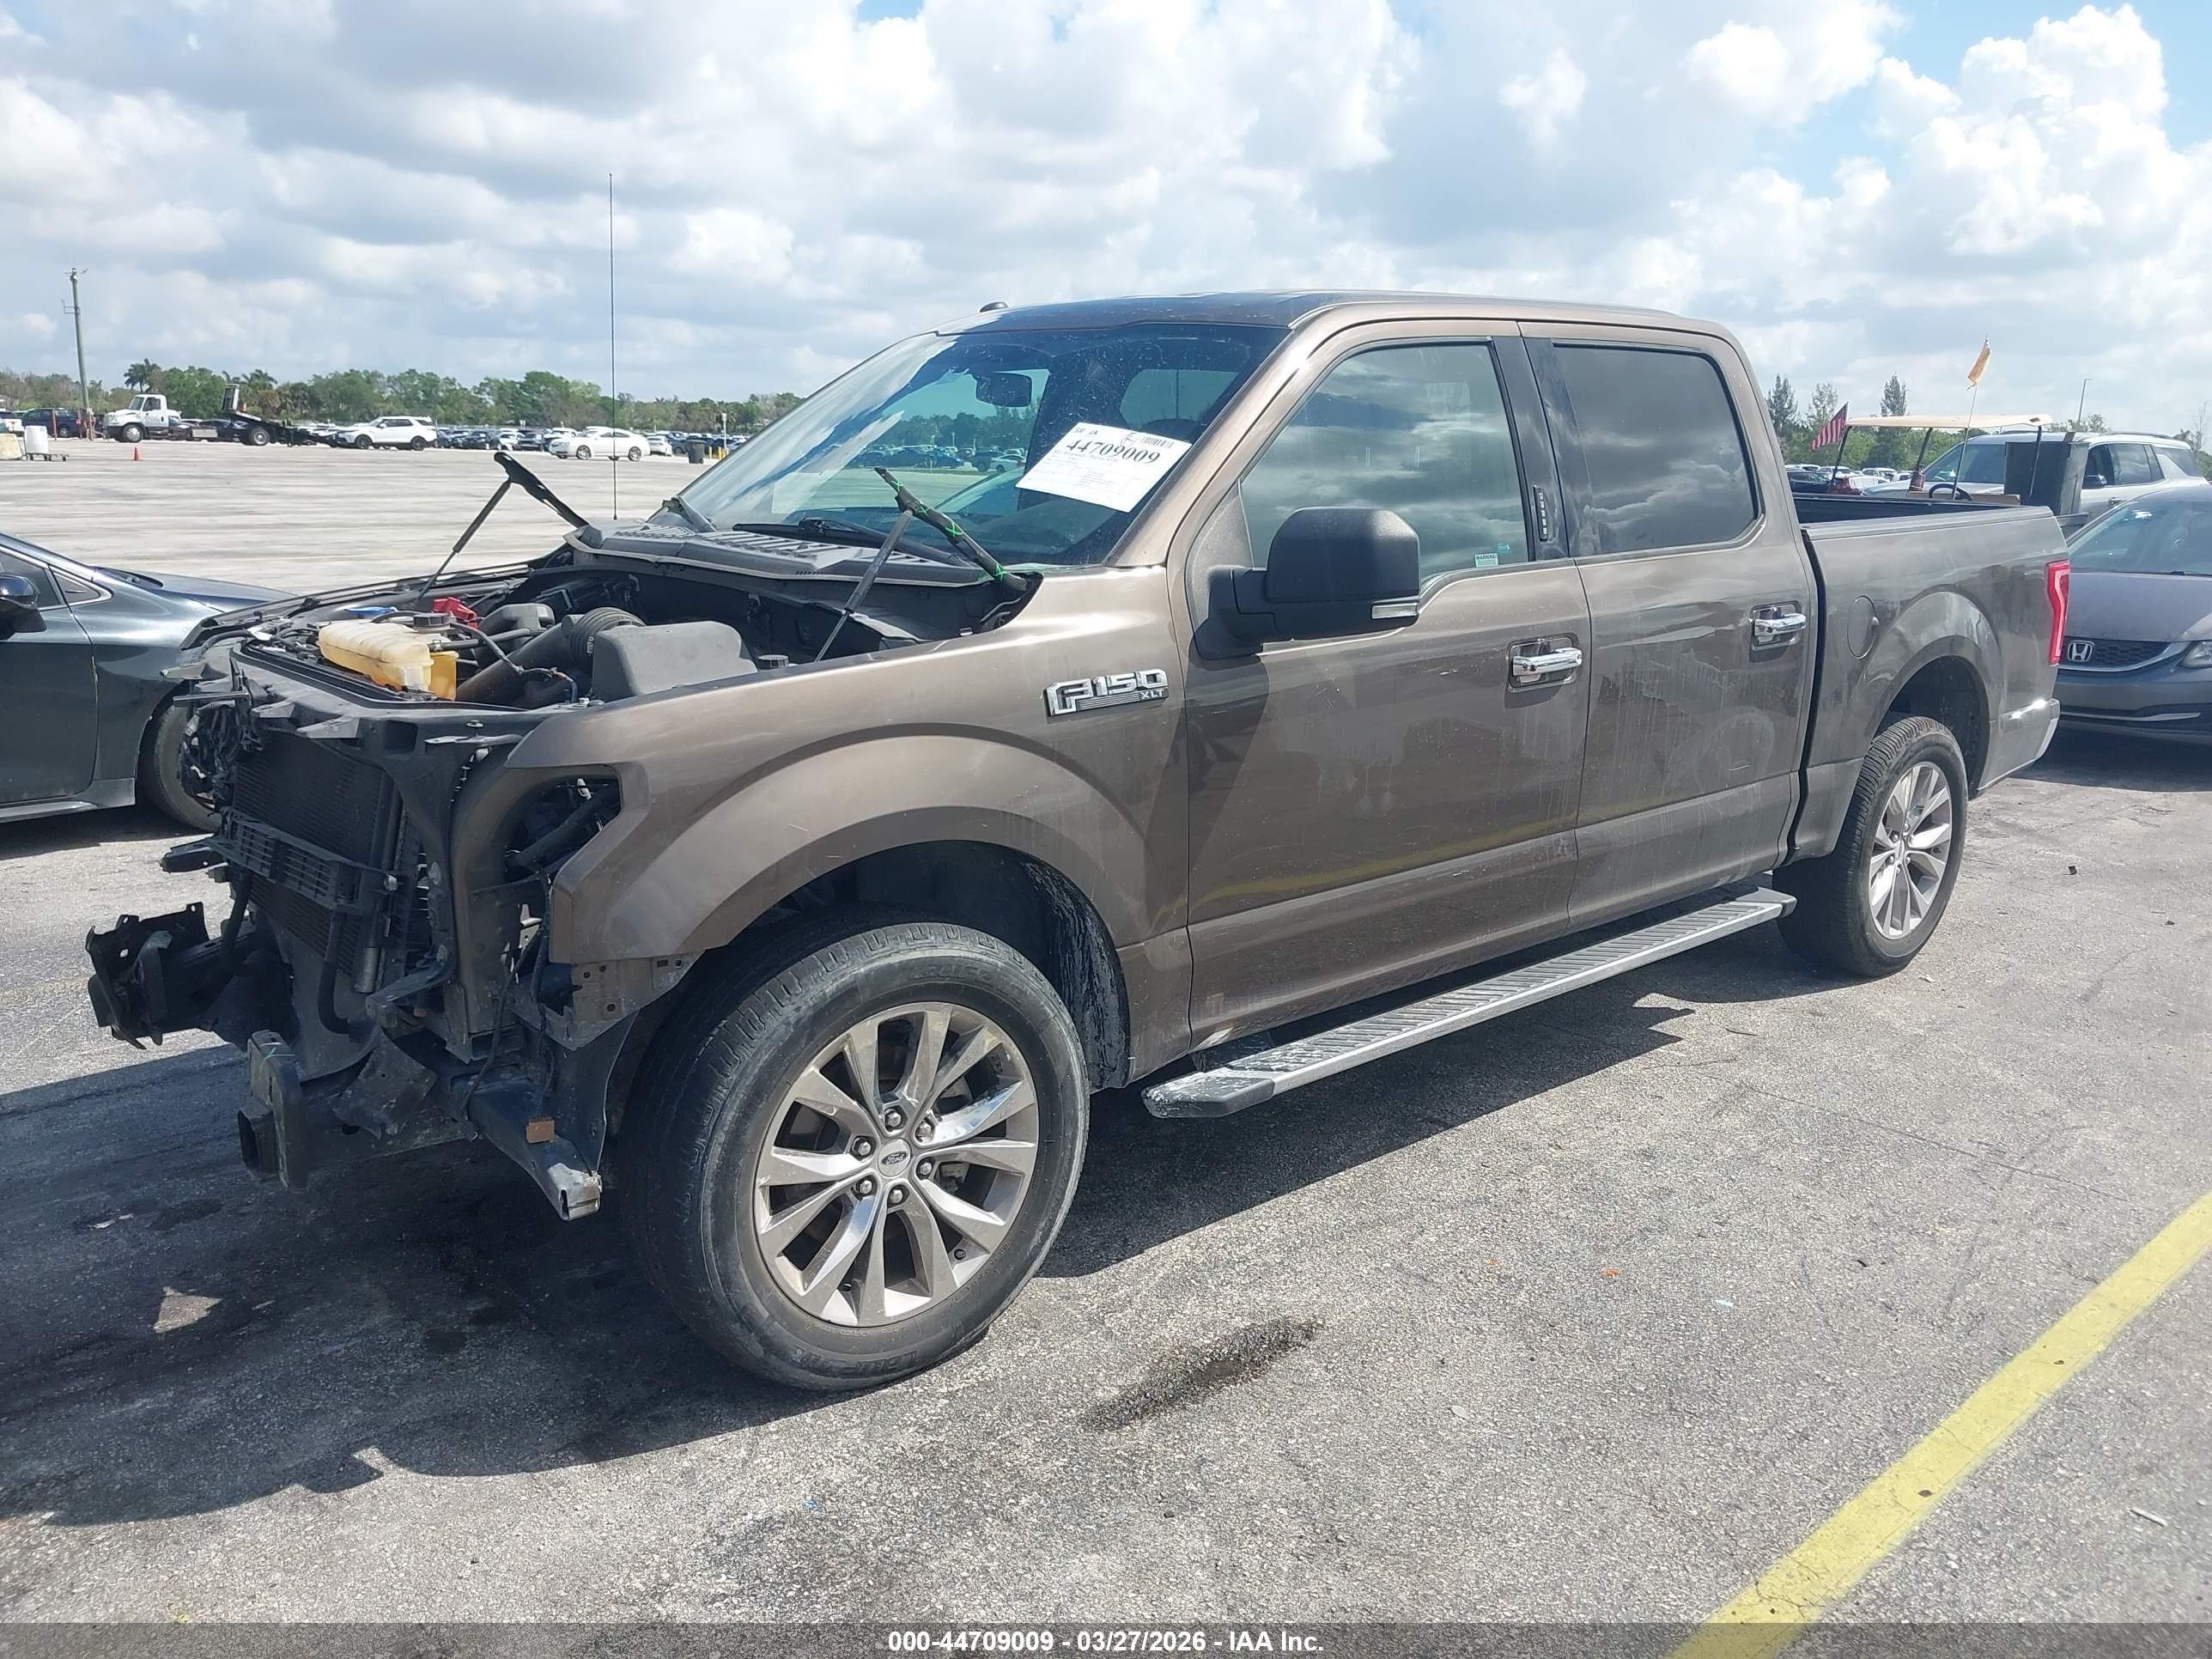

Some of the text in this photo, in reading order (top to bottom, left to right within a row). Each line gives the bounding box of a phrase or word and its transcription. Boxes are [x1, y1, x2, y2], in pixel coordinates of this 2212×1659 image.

[1066, 439, 1161, 465] 44709009
[1140, 689, 1165, 700] XLT
[885, 1152, 905, 1164] Ford
